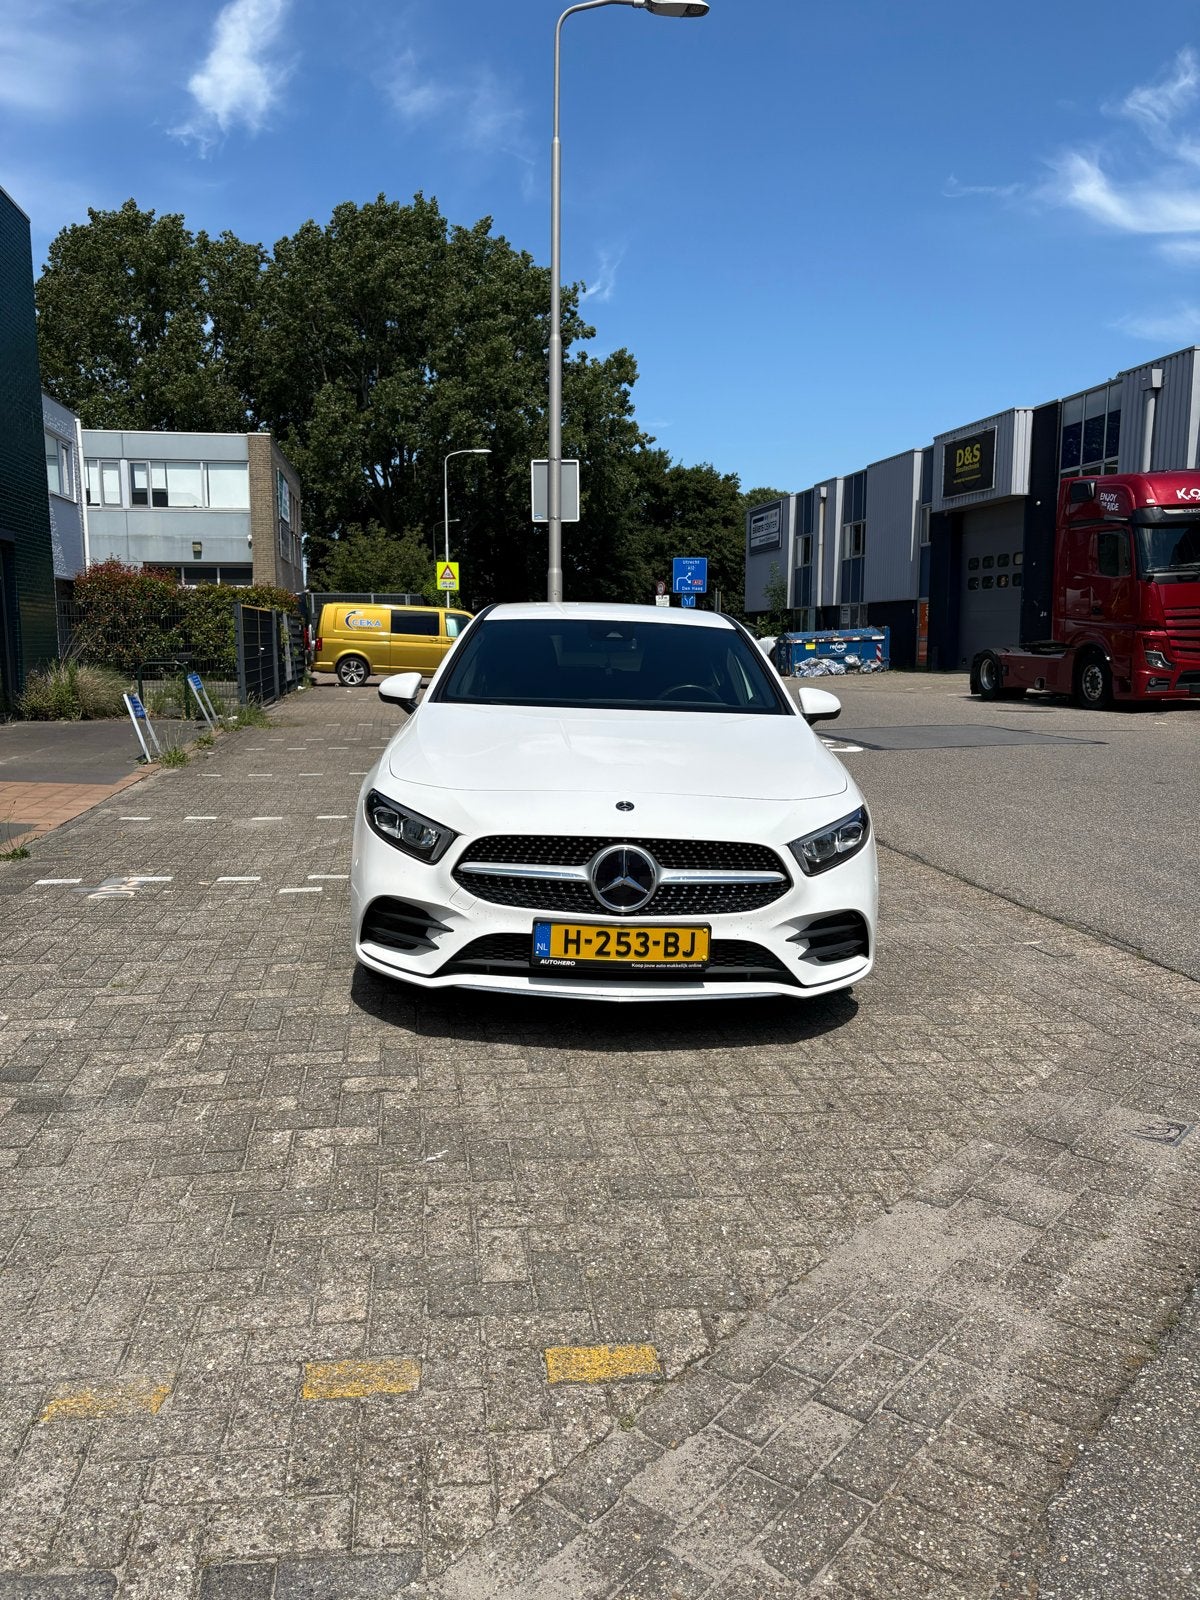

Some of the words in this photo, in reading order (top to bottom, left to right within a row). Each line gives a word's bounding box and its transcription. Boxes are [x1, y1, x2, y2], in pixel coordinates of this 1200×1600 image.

[956, 443, 981, 468] D&S
[1100, 492, 1118, 502] ENJOY
[1106, 502, 1120, 512] RIDE
[536, 942, 549, 951] NL
[563, 928, 696, 958] H-253-BJ
